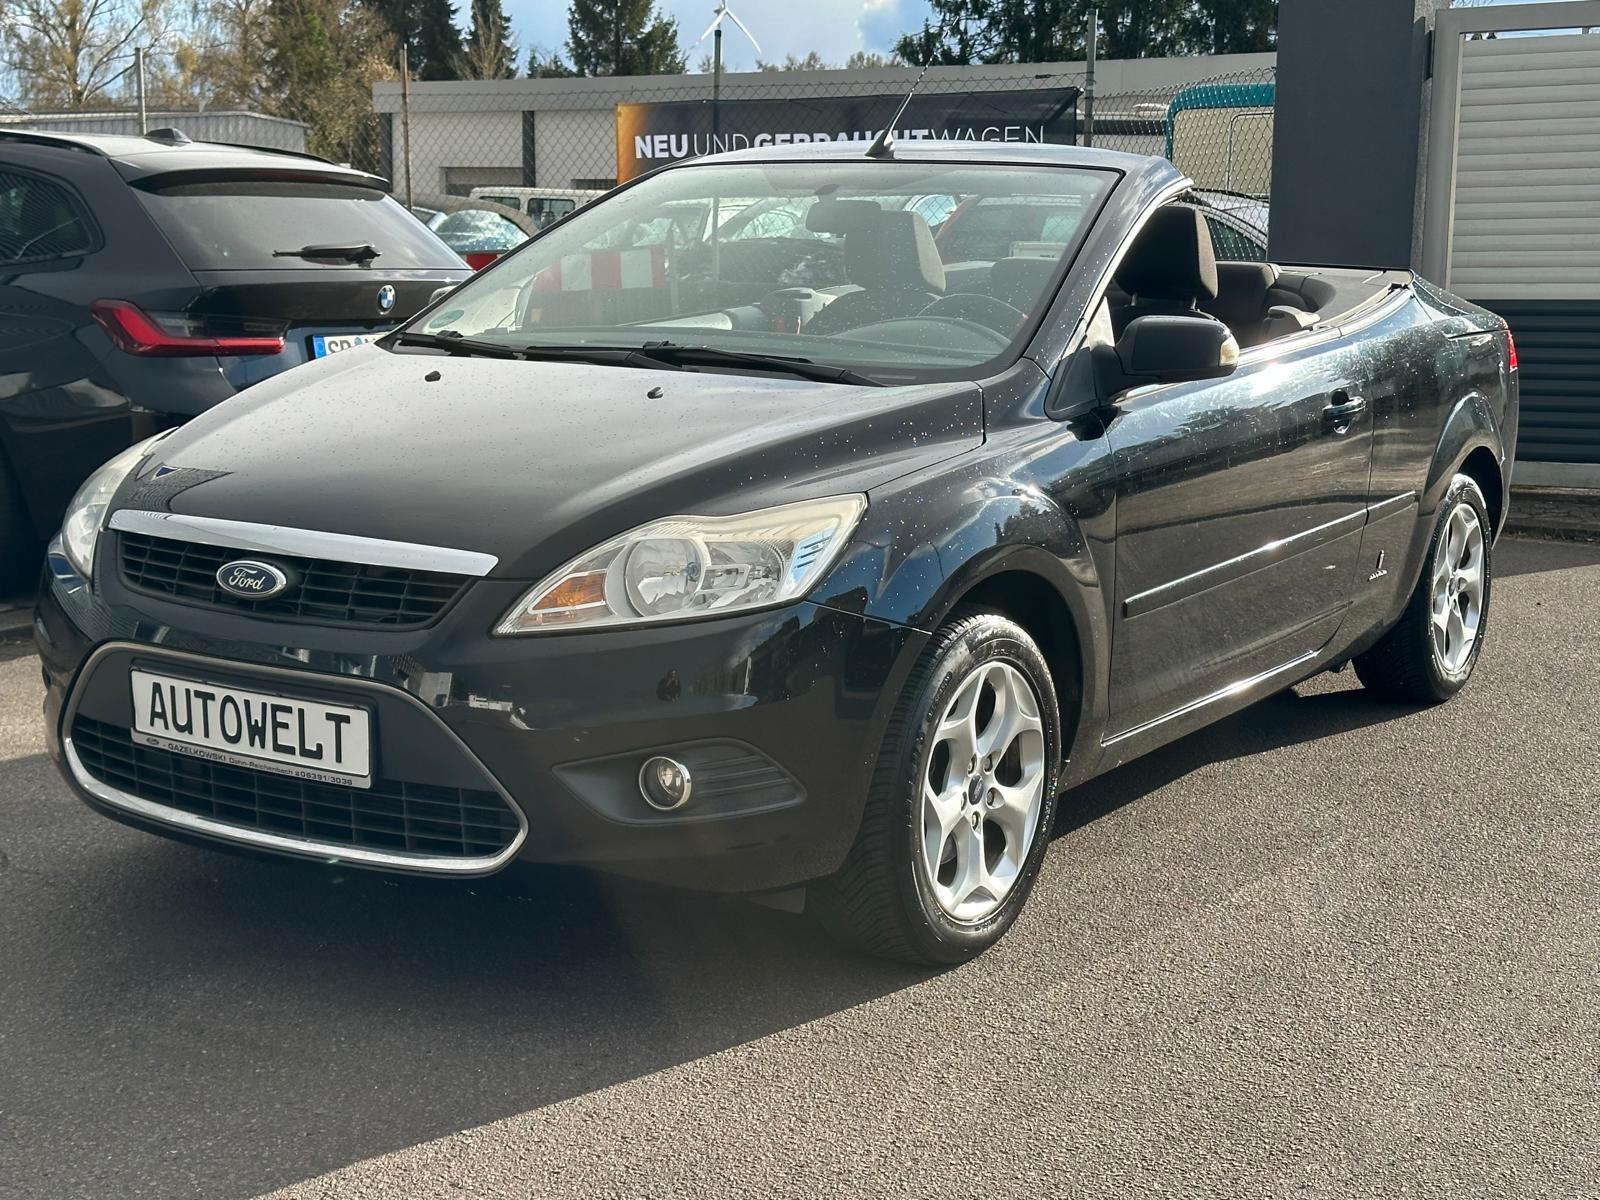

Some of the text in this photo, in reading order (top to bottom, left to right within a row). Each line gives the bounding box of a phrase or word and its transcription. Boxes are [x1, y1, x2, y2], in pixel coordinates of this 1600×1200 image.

[634, 133, 688, 159] NEU
[693, 132, 750, 157] UND
[229, 567, 266, 590] Ford
[150, 681, 351, 764] AUTOWELT
